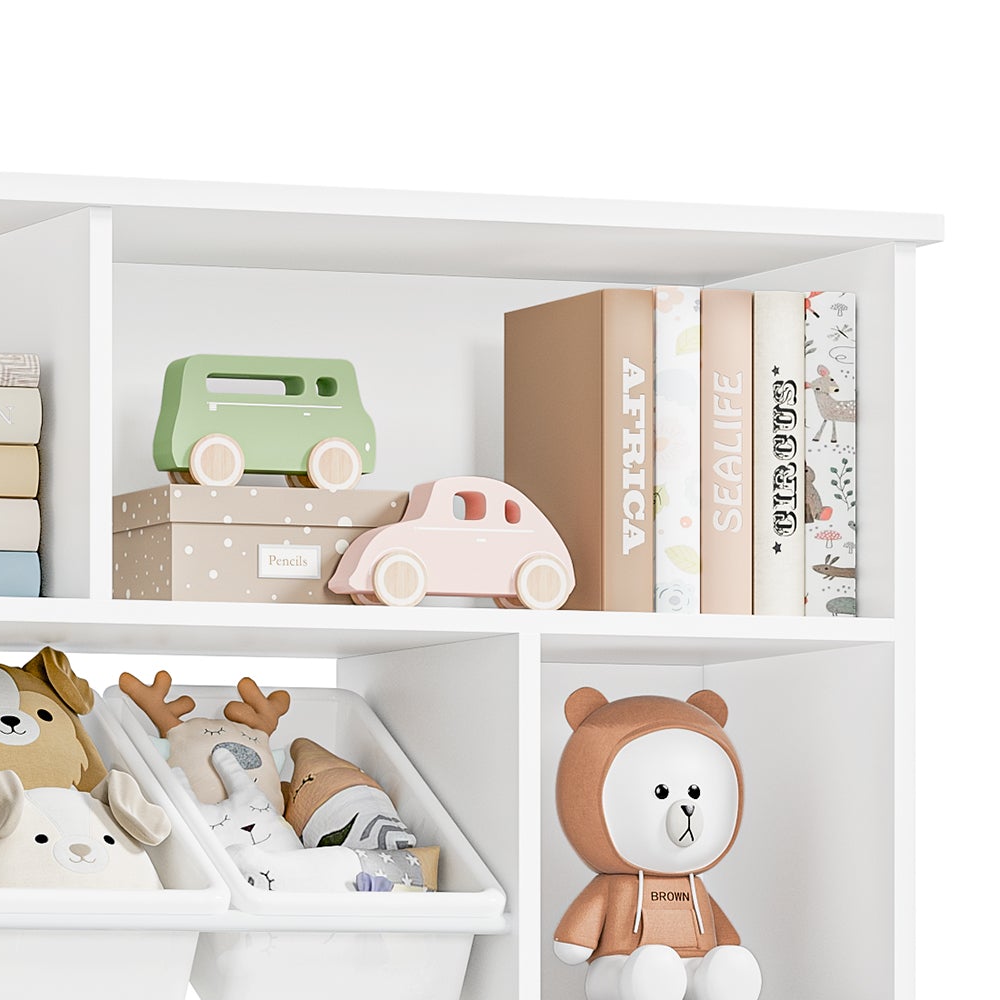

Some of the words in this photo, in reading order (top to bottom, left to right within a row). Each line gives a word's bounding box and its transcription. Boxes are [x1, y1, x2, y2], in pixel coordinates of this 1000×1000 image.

[622, 357, 646, 556] AFRICA
[712, 370, 743, 534] SEALIFE
[772, 379, 798, 537] CIRCUS
[268, 554, 308, 567] Pencils
[651, 891, 690, 902] BROWN
